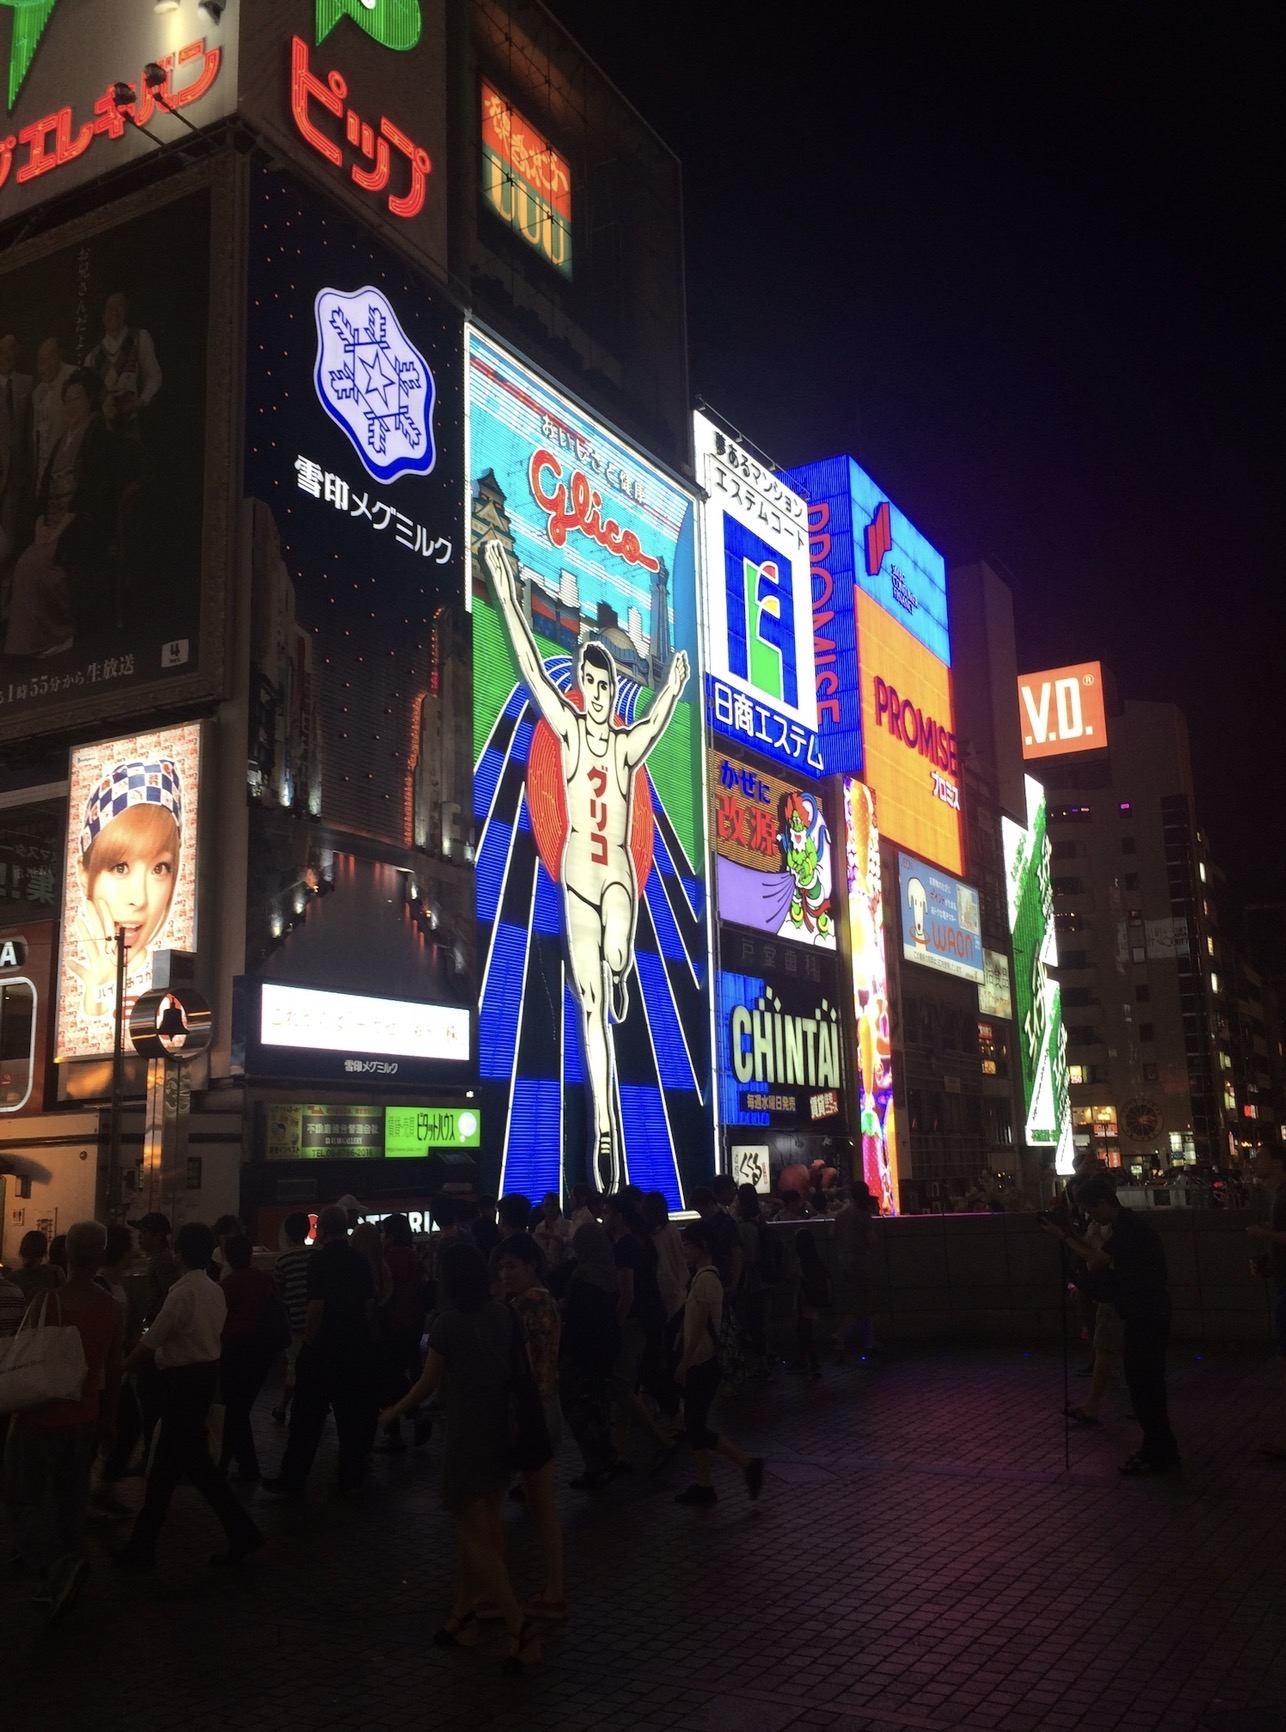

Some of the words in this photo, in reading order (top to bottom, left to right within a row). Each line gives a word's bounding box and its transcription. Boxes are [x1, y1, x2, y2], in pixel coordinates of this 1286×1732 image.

[291, 35, 432, 218] ピップ
[542, 414, 646, 504] おいしさと健康
[713, 430, 803, 518] 夢あるマンション
[293, 454, 454, 566] 雪印メグミルク
[528, 448, 661, 572] Glico
[715, 466, 805, 550] エステムコート
[714, 681, 825, 771] 日商エステム
[873, 674, 959, 779] PROMISE
[587, 764, 608, 867] グリコ
[719, 760, 771, 804] かぜに
[930, 770, 961, 811] プロミス
[716, 794, 779, 857] 改源
[931, 921, 975, 961] WAON
[344, 1059, 399, 1074] 雪印メグミルク
[732, 993, 840, 1089] CHINTAI
[417, 1112, 455, 1141] ピタットハウス
[746, 1092, 797, 1113] 毎週水曜日発売
[740, 1151, 763, 1187] くくる
